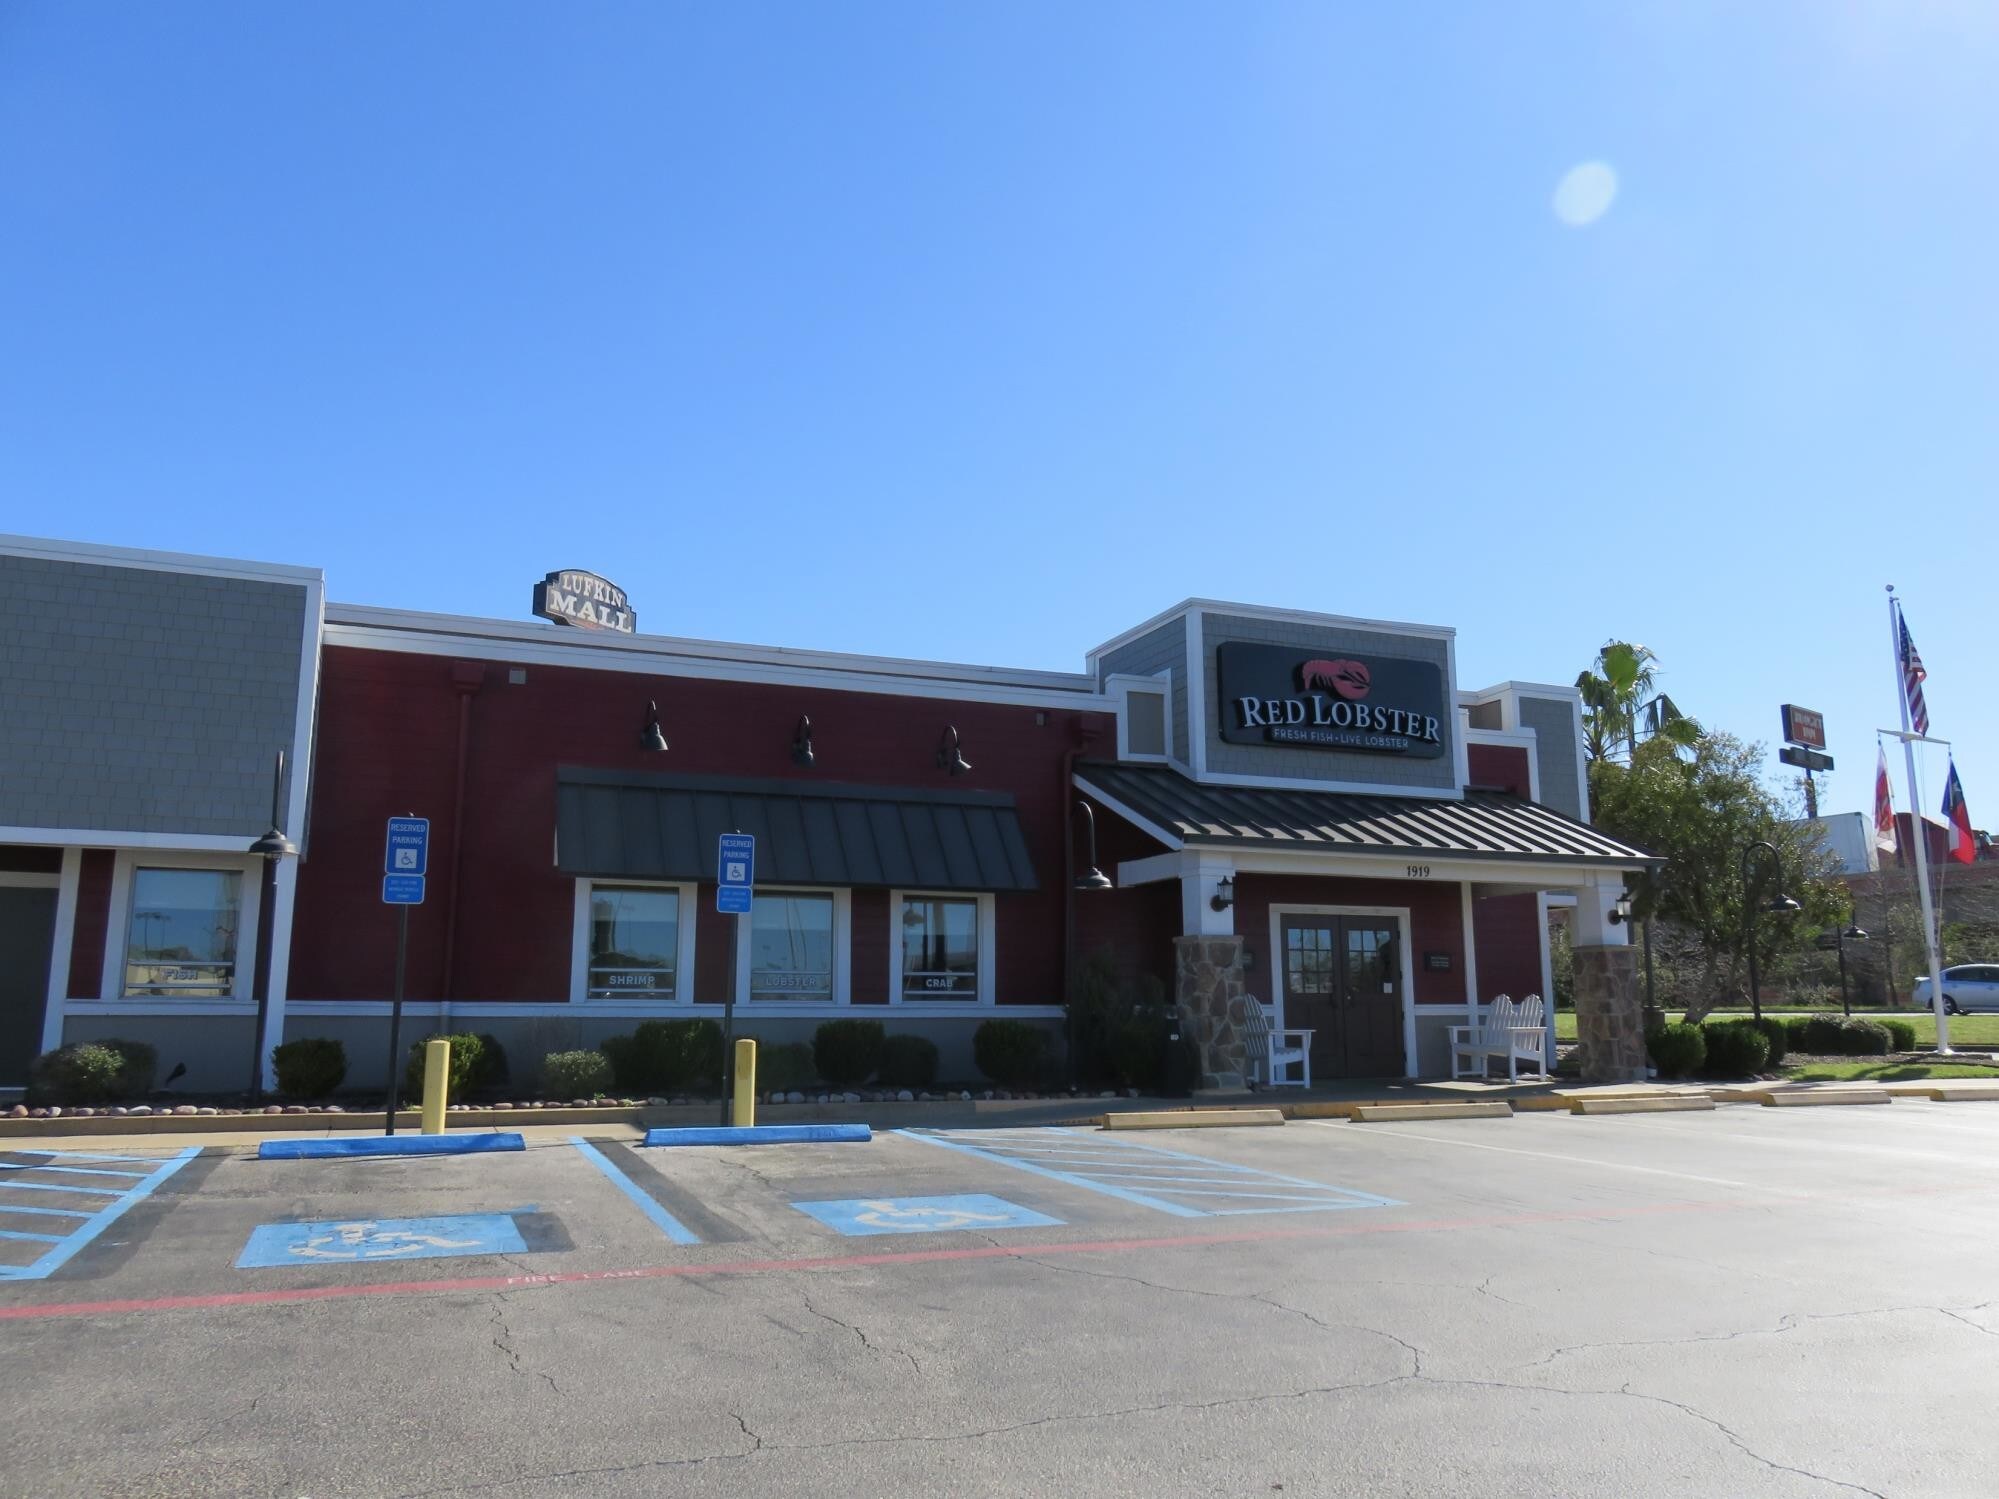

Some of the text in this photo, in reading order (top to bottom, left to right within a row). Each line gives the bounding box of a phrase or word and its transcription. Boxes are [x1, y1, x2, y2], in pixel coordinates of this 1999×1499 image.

[562, 574, 623, 608] LUFKIN
[550, 590, 632, 633] MALL
[1240, 695, 1440, 742] RED LOBSTER
[1274, 728, 1408, 748] FRESH FISH LIVE LOBSTER
[391, 823, 426, 832] RESERVED
[392, 835, 423, 845] PARKING
[722, 839, 752, 848] RESERVED
[1407, 865, 1430, 878] 1919
[163, 968, 199, 981] FISH
[609, 975, 656, 985] SHRIMP
[766, 976, 816, 987] LOBSTER
[926, 978, 953, 988] CRAB
[507, 1269, 649, 1284] FIRE LANE
